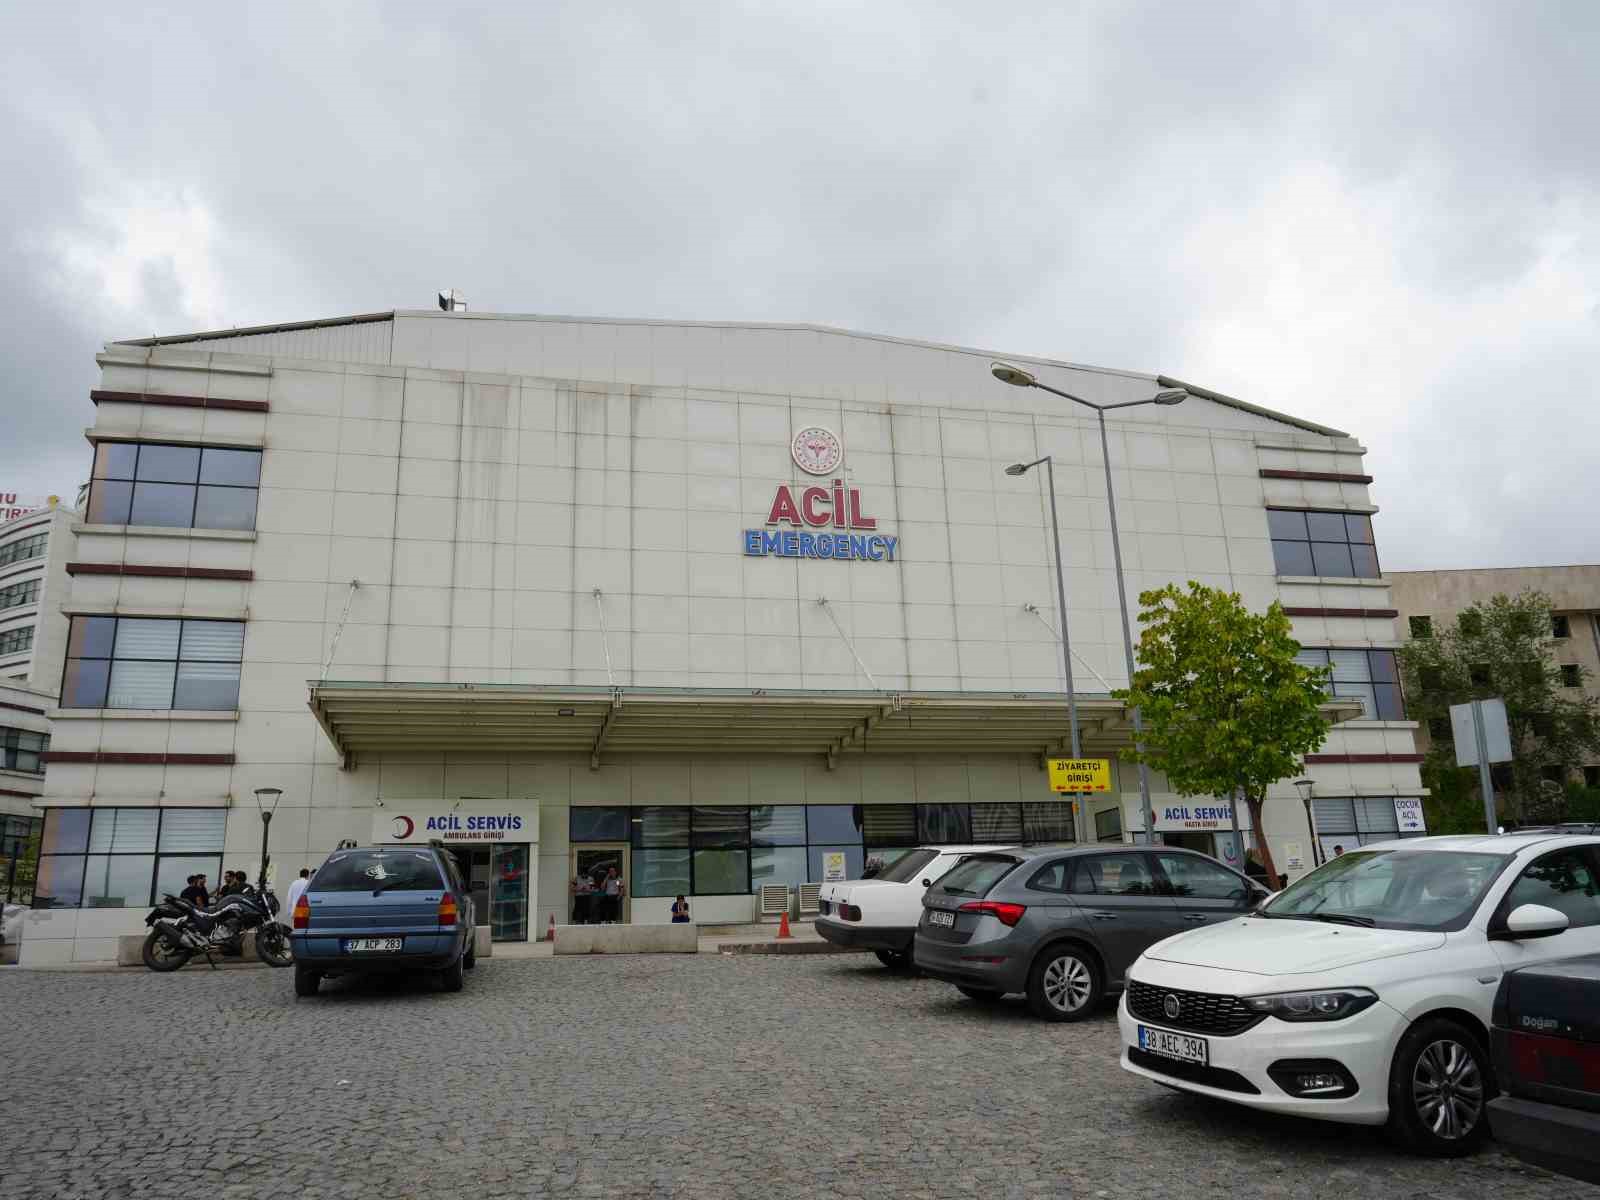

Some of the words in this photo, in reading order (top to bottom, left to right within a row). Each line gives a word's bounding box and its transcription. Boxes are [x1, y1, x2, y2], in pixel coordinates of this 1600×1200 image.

[766, 479, 877, 529] ACİL
[744, 529, 898, 562] EMERGENCY
[426, 813, 462, 830] ACİL
[467, 812, 522, 830] SERVİS
[1165, 804, 1191, 820] ACİL
[384, 939, 401, 949] 283
[1145, 1030, 1157, 1048] 38
[1161, 1033, 1180, 1054] AEC
[1183, 1038, 1204, 1059] 394
